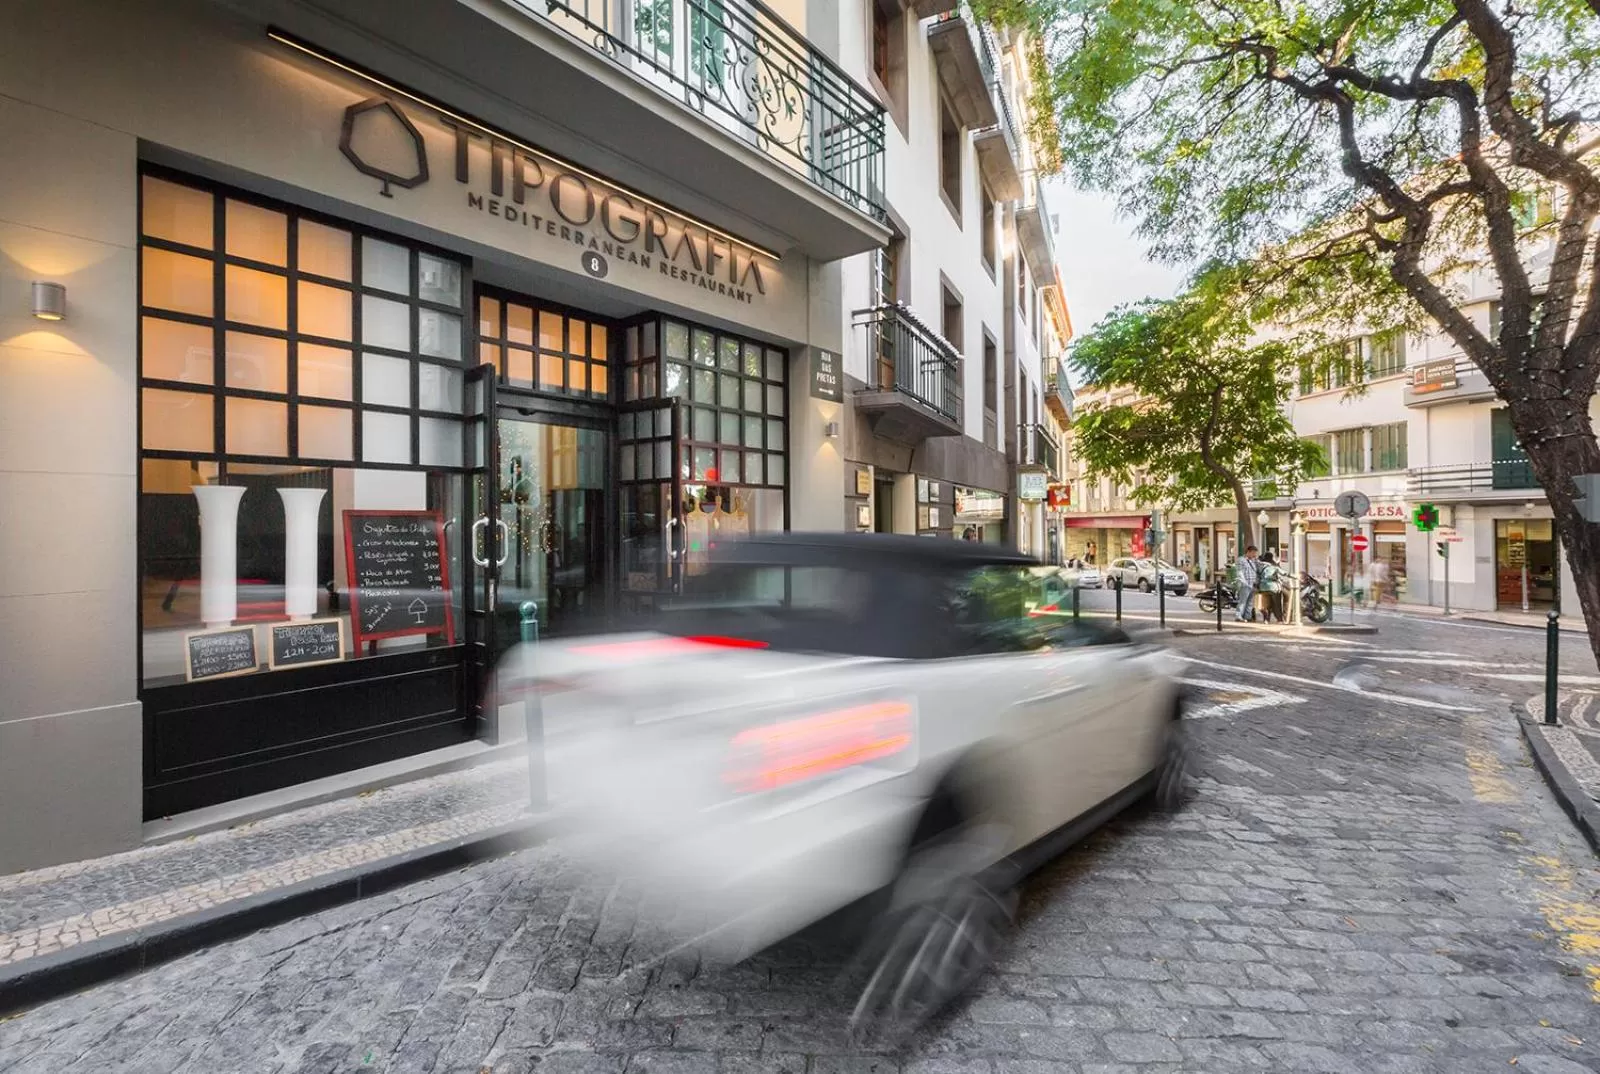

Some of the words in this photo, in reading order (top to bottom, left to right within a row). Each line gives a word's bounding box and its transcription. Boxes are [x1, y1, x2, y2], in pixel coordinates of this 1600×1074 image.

[441, 116, 765, 296] TIPOGRAFIA
[467, 192, 651, 270] MEDITERRANEAN
[659, 261, 754, 304] RESTAURANT
[816, 371, 836, 385] PRETAS
